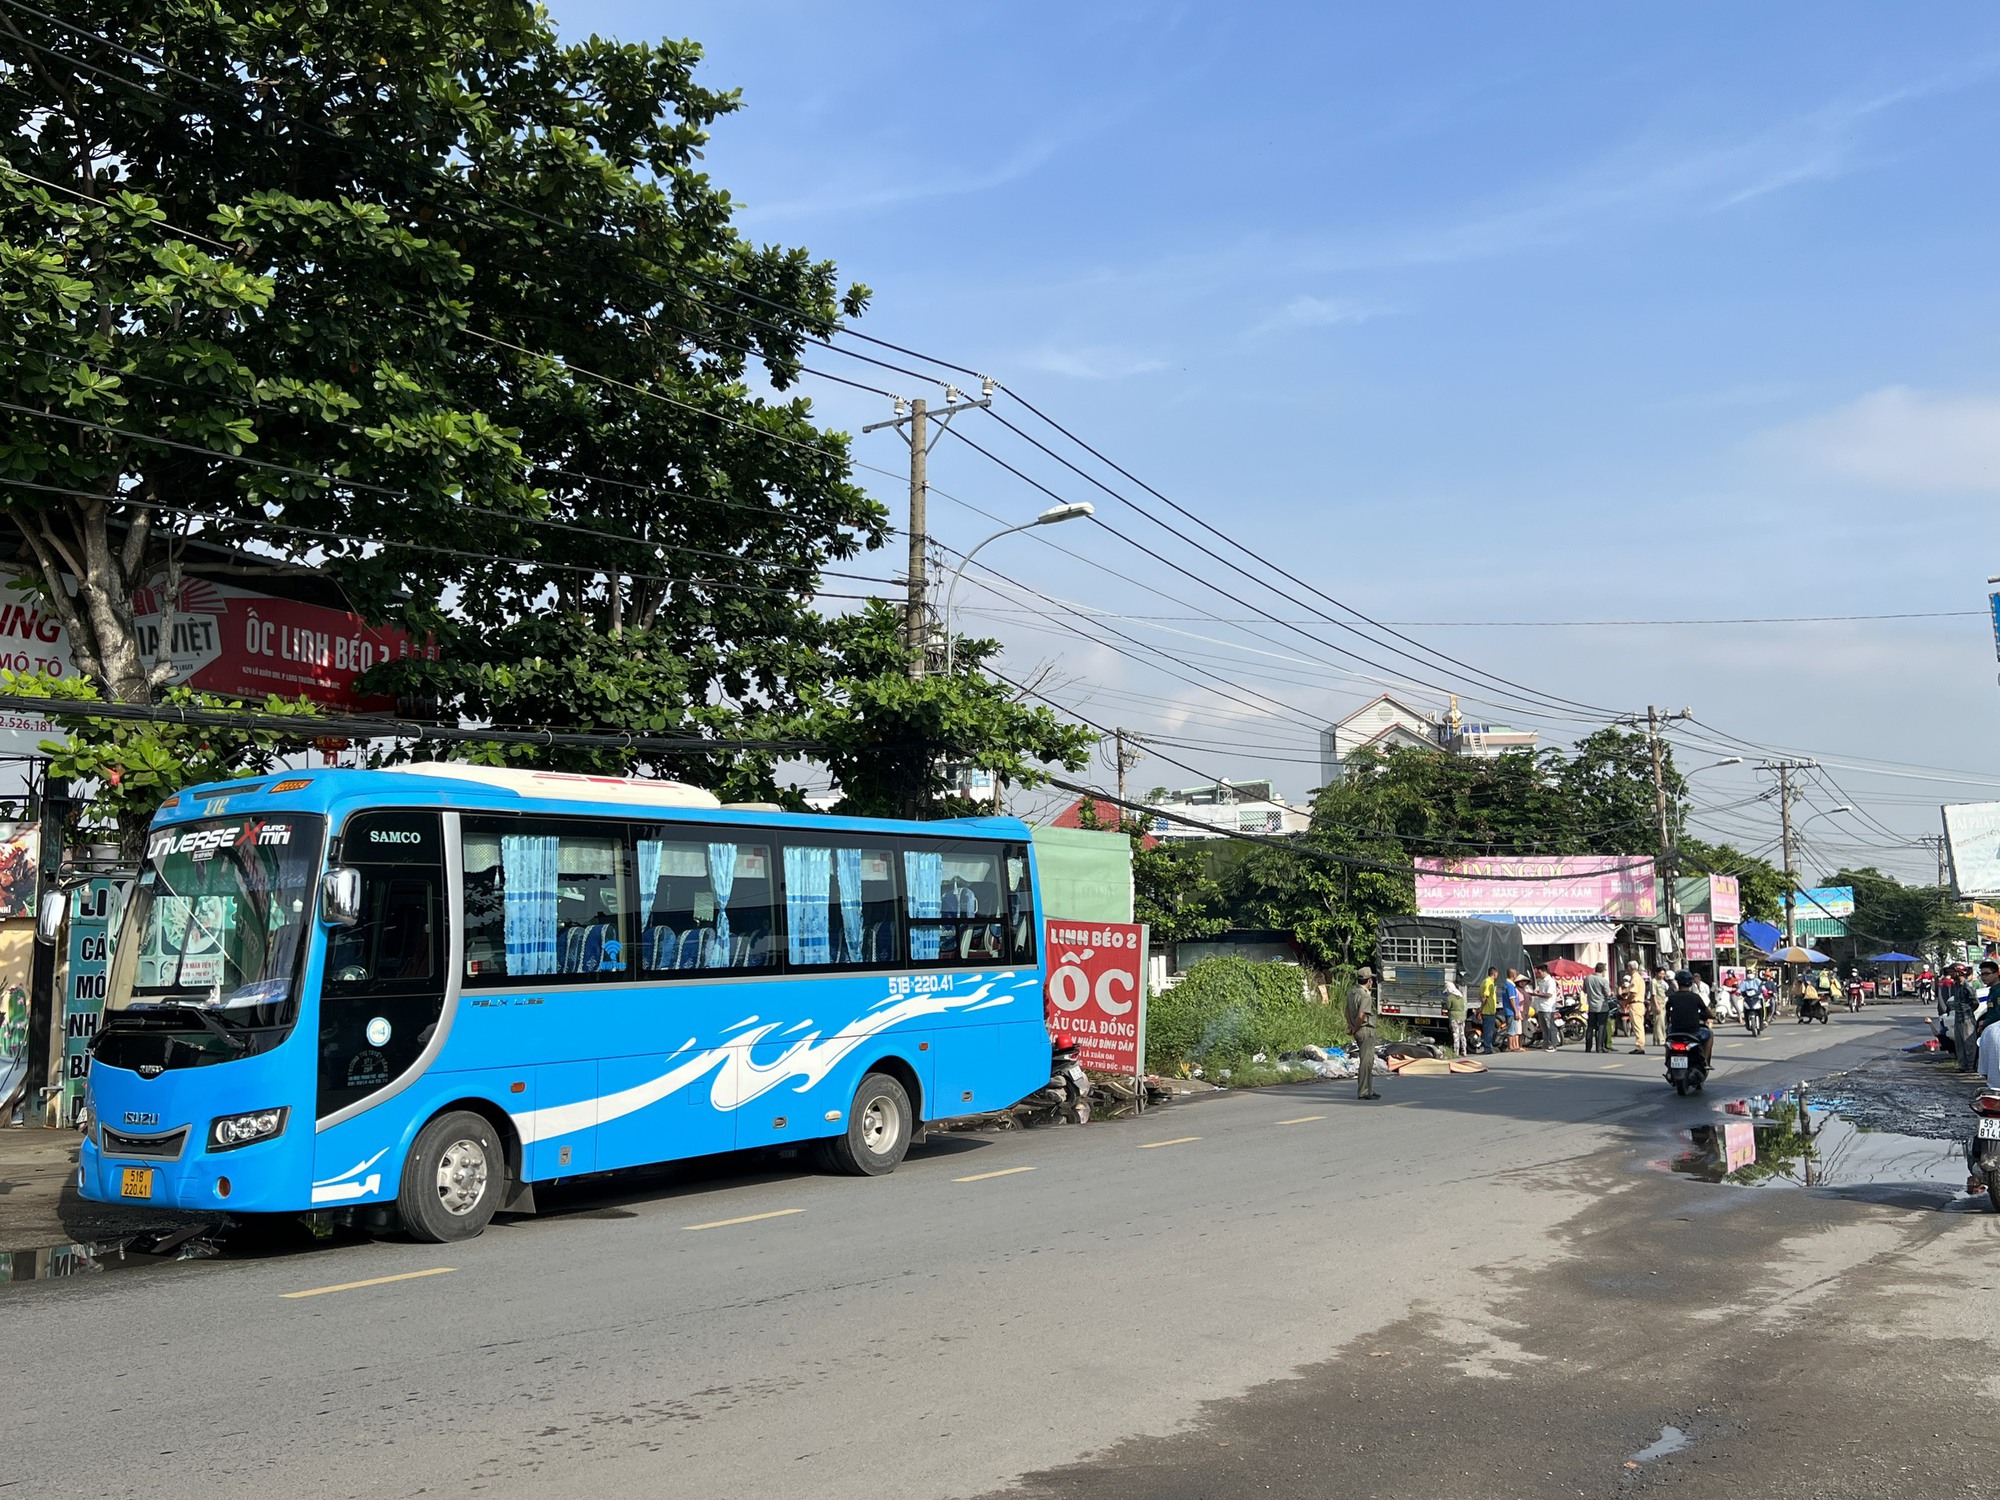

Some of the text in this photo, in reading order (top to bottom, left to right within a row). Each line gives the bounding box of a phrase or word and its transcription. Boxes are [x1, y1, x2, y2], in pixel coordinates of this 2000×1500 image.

[281, 624, 329, 667] LINH
[335, 632, 373, 674] BÉO
[34, 656, 63, 677] TÔ
[370, 830, 421, 844] SAMCO
[1424, 887, 1443, 898] NAIL
[1492, 887, 1518, 898] MAKE
[1051, 926, 1137, 949] LINH BÉO 2
[1050, 948, 1134, 1016] ỐC
[470, 999, 508, 1008] FELIX
[1050, 1010, 1135, 1037] ẨU CUA ĐỒNG
[1118, 1039, 1134, 1052] DÂN
[124, 1112, 159, 1125] ISUZU
[1984, 1119, 2000, 1129] 59-
[1980, 1128, 2000, 1139] 814.
[130, 1170, 144, 1183] 51B
[124, 1183, 148, 1197] 220.41
